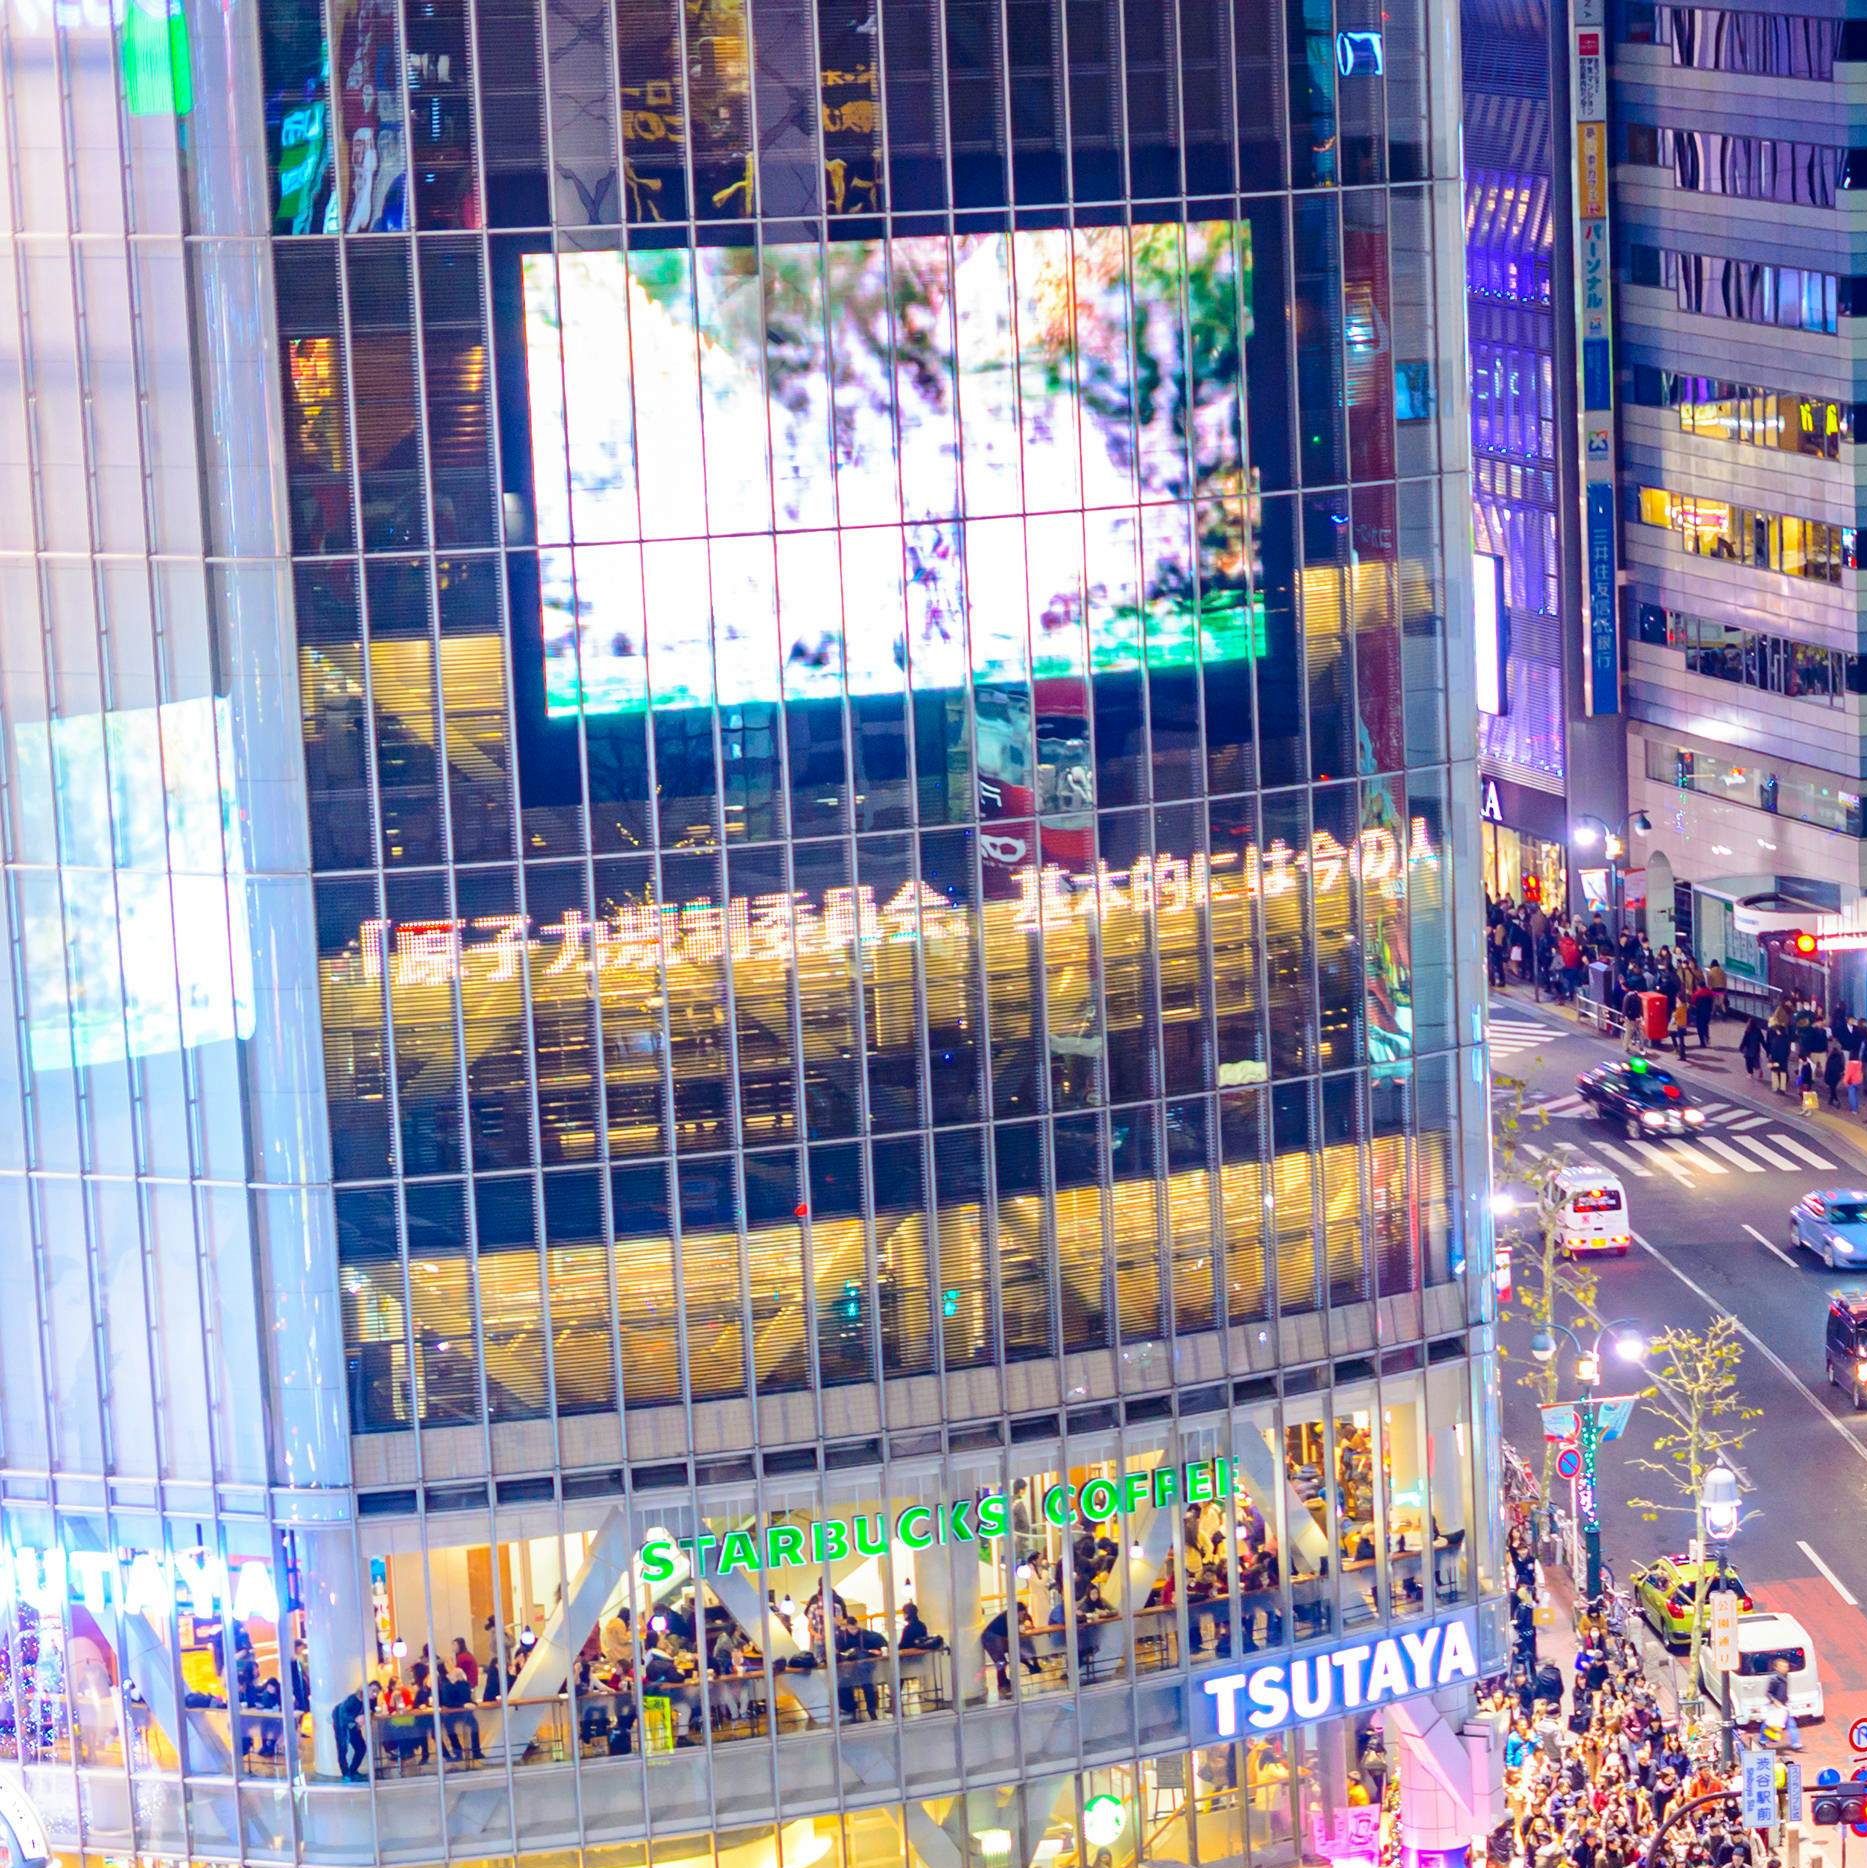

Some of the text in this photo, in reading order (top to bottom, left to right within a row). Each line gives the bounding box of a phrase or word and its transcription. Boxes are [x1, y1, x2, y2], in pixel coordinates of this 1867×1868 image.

[1585, 223, 1602, 309] パーソナル
[1481, 781, 1503, 822] A
[641, 1456, 1242, 1582] STARBUCKS COFFEE
[1204, 1620, 1477, 1737] TSUTAYA
[1755, 1756, 1772, 1822] 渋谷駅前
